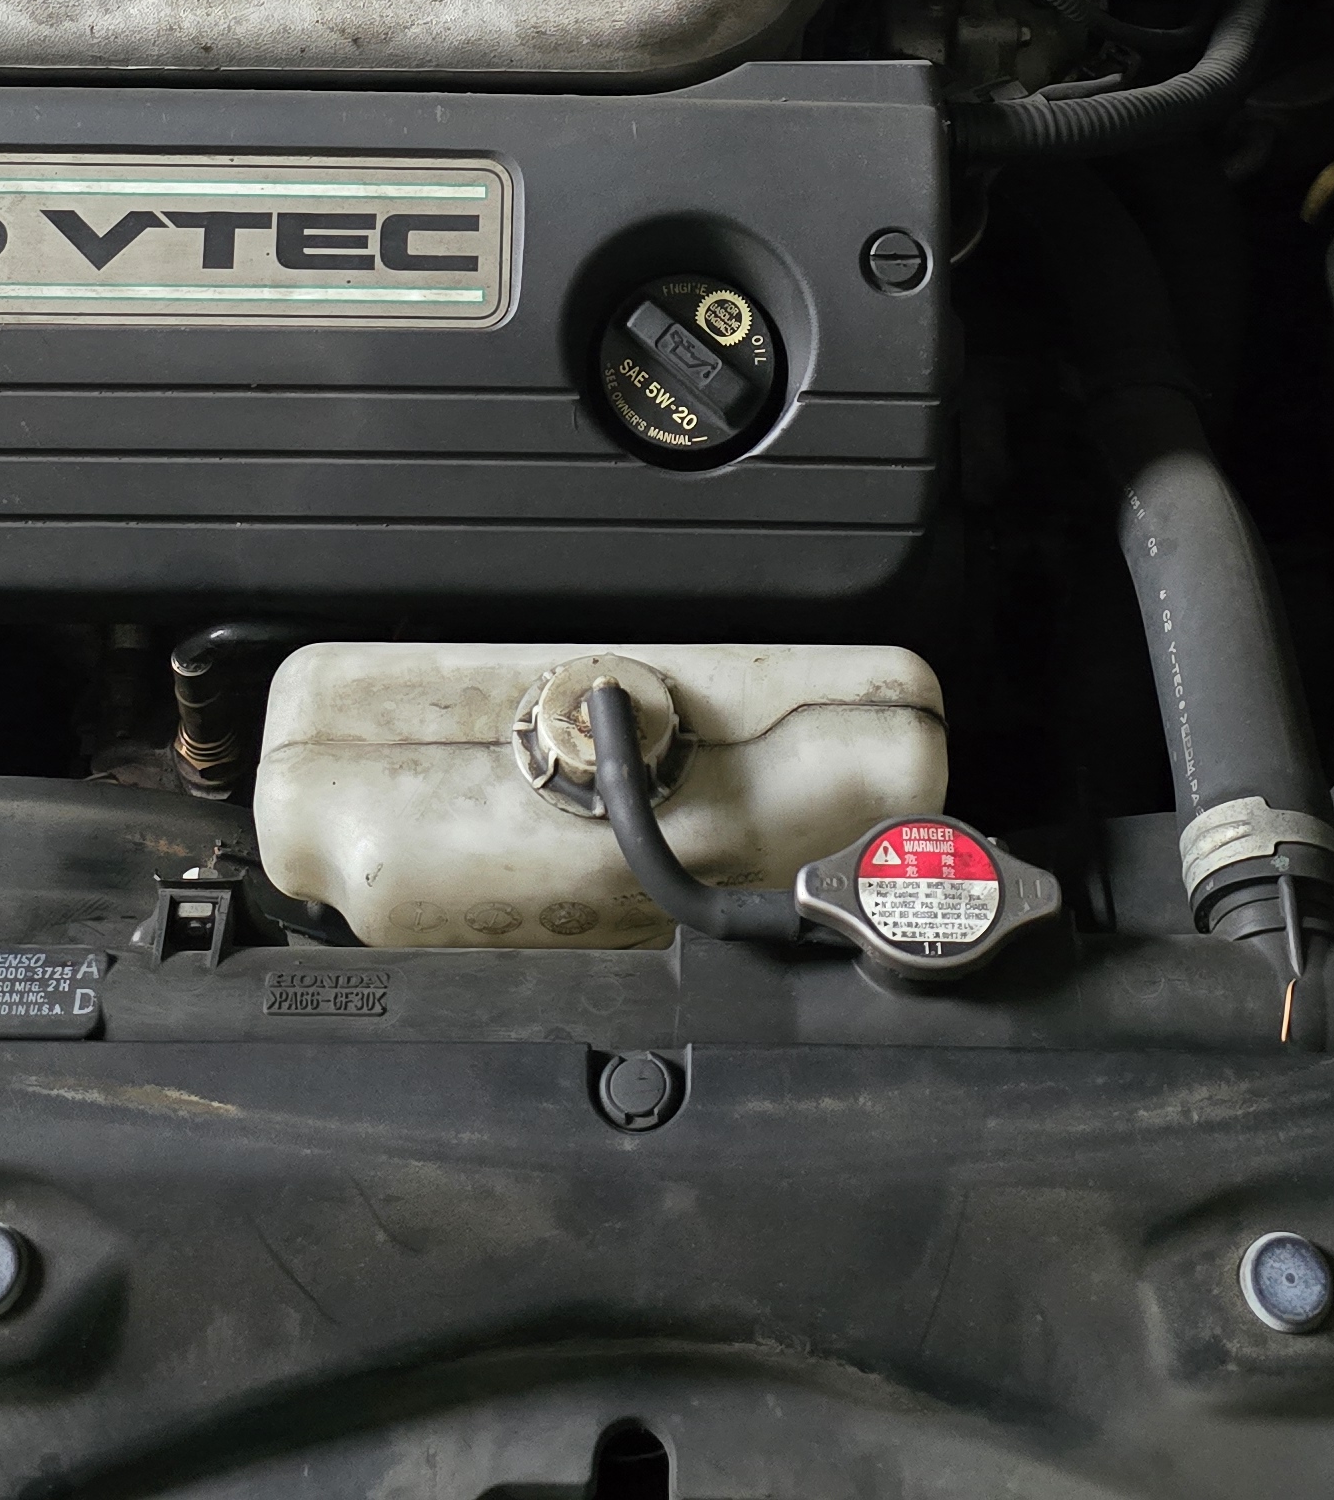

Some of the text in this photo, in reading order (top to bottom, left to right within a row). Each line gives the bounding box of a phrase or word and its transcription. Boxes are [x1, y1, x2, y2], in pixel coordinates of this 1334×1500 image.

[39, 208, 481, 273] VTEC
[724, 302, 739, 317] FOR
[751, 335, 767, 365] OIL
[619, 358, 698, 430] SAE 5W-20
[612, 391, 647, 432] OWNER'S
[902, 828, 954, 840] DANGER
[903, 841, 955, 853] WARNUNG
[902, 881, 921, 889] OPEN
[924, 891, 938, 899] will
[878, 910, 896, 918] NICHT
[941, 912, 962, 920] MOTOR
[923, 941, 942, 955] 1.1
[76, 954, 99, 979] A
[15, 981, 43, 992] MFG.
[268, 973, 389, 989] HONDA
[23, 992, 49, 1003] INC.
[72, 988, 97, 1015] D
[12, 1004, 26, 1015] IN
[29, 1003, 65, 1016] U.S.A.
